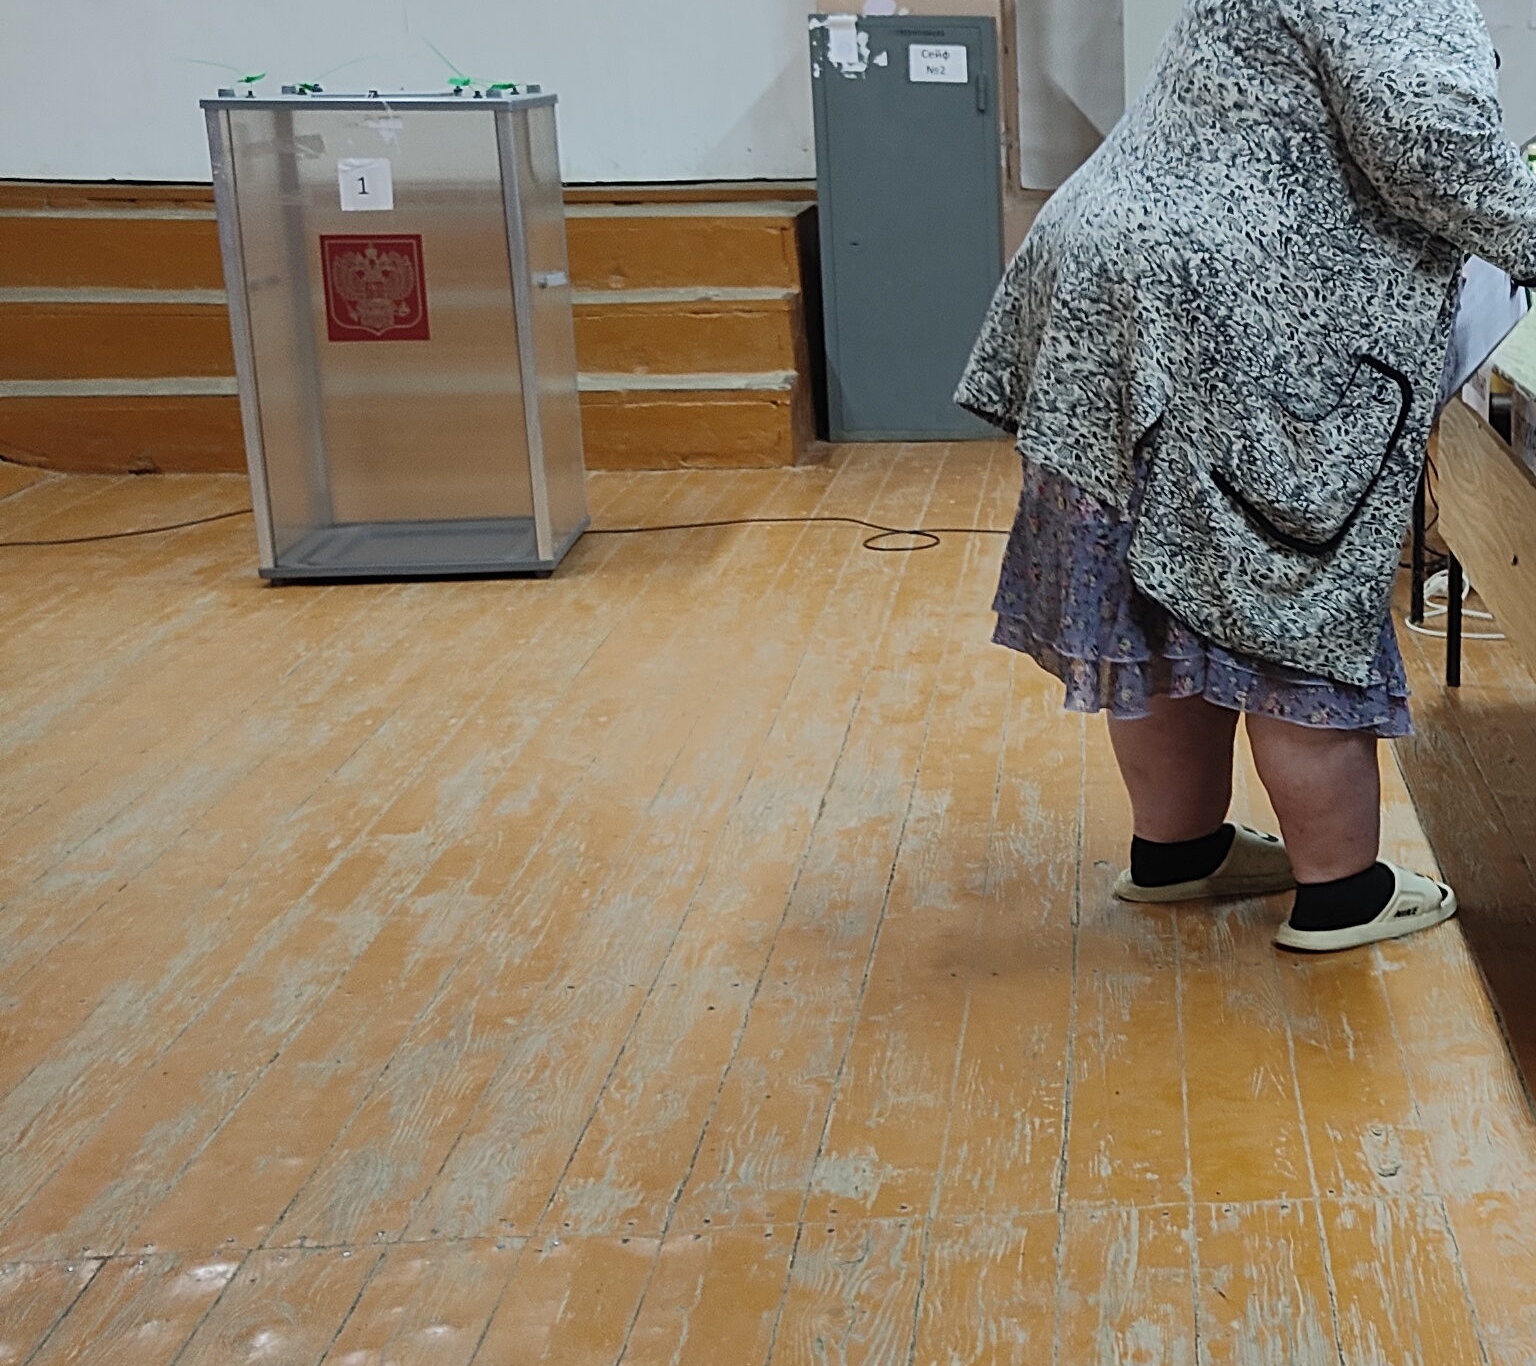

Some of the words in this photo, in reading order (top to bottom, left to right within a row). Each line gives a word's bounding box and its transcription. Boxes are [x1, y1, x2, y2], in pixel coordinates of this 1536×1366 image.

[921, 48, 951, 62] Сейф
[926, 65, 947, 76] №2
[356, 176, 369, 195] 1
